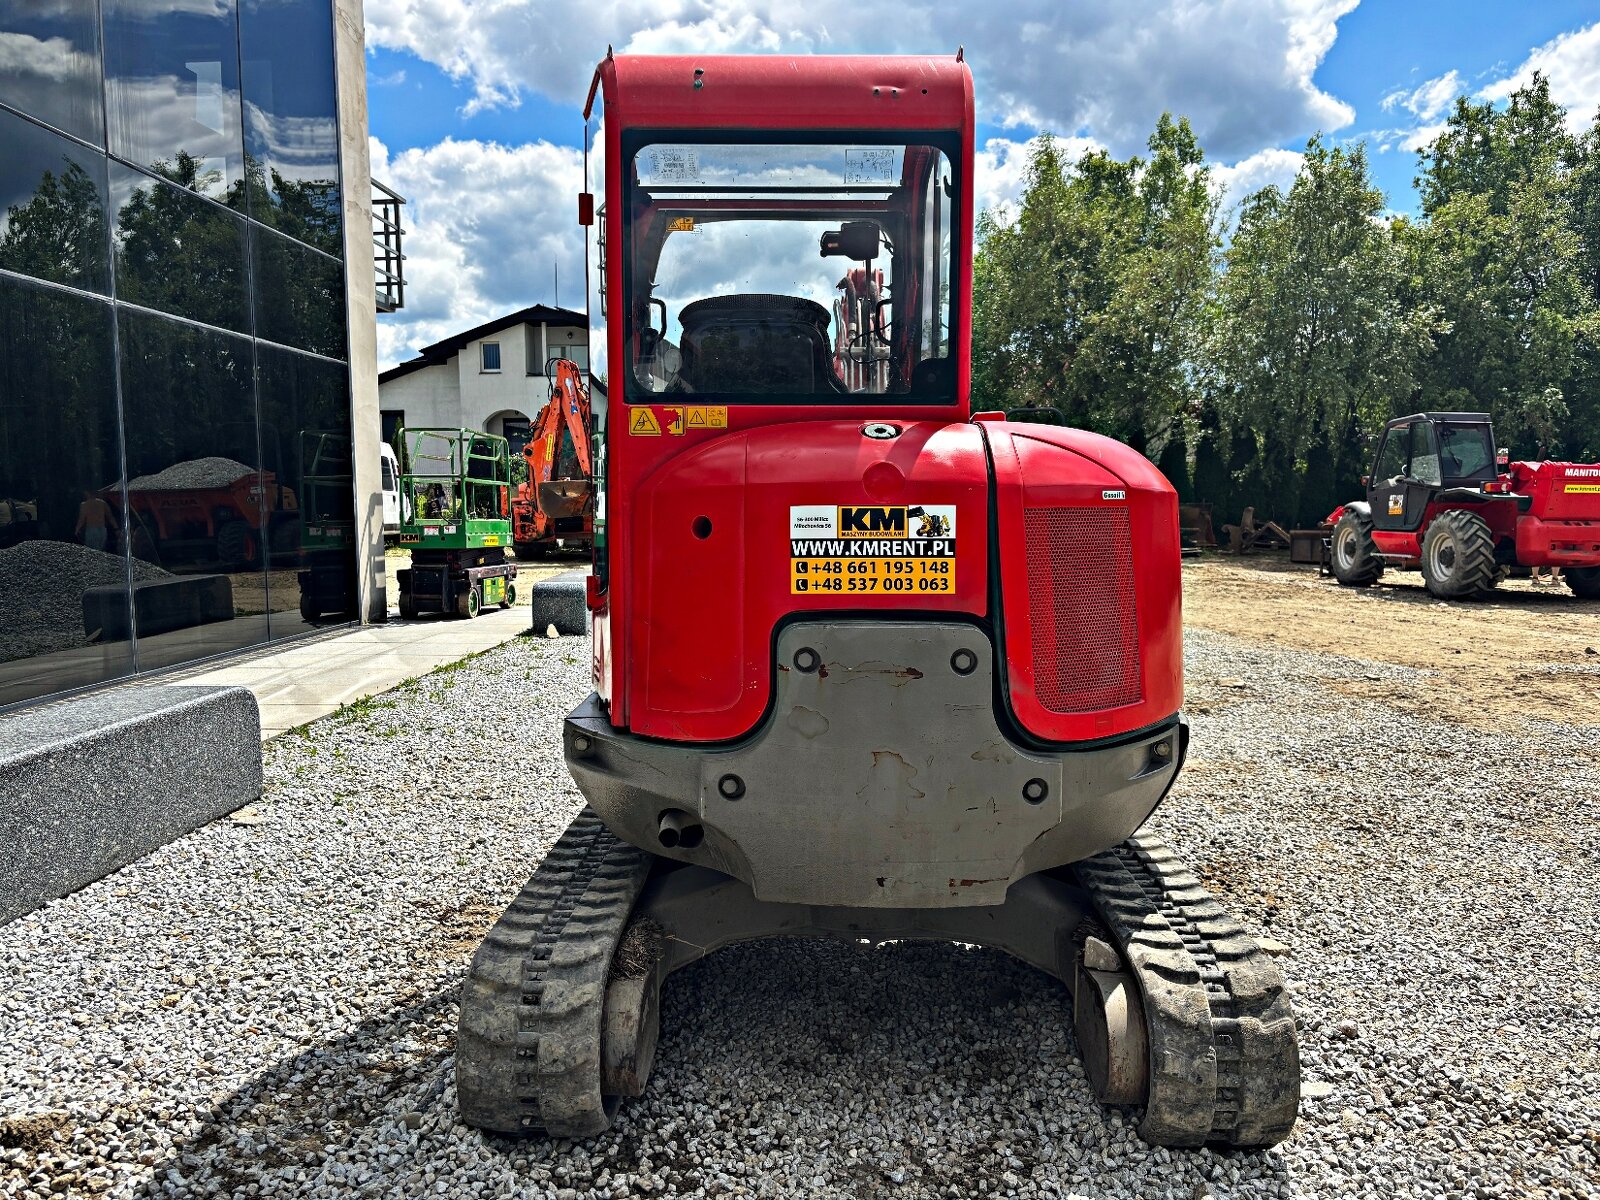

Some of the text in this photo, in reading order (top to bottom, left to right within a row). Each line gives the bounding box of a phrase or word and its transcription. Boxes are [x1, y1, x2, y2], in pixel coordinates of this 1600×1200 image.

[841, 508, 905, 531] KM
[792, 540, 954, 556] WWW.KMRENT.PL
[811, 561, 949, 574] +48 661 195 148
[811, 578, 949, 591] +48 537 003 063
